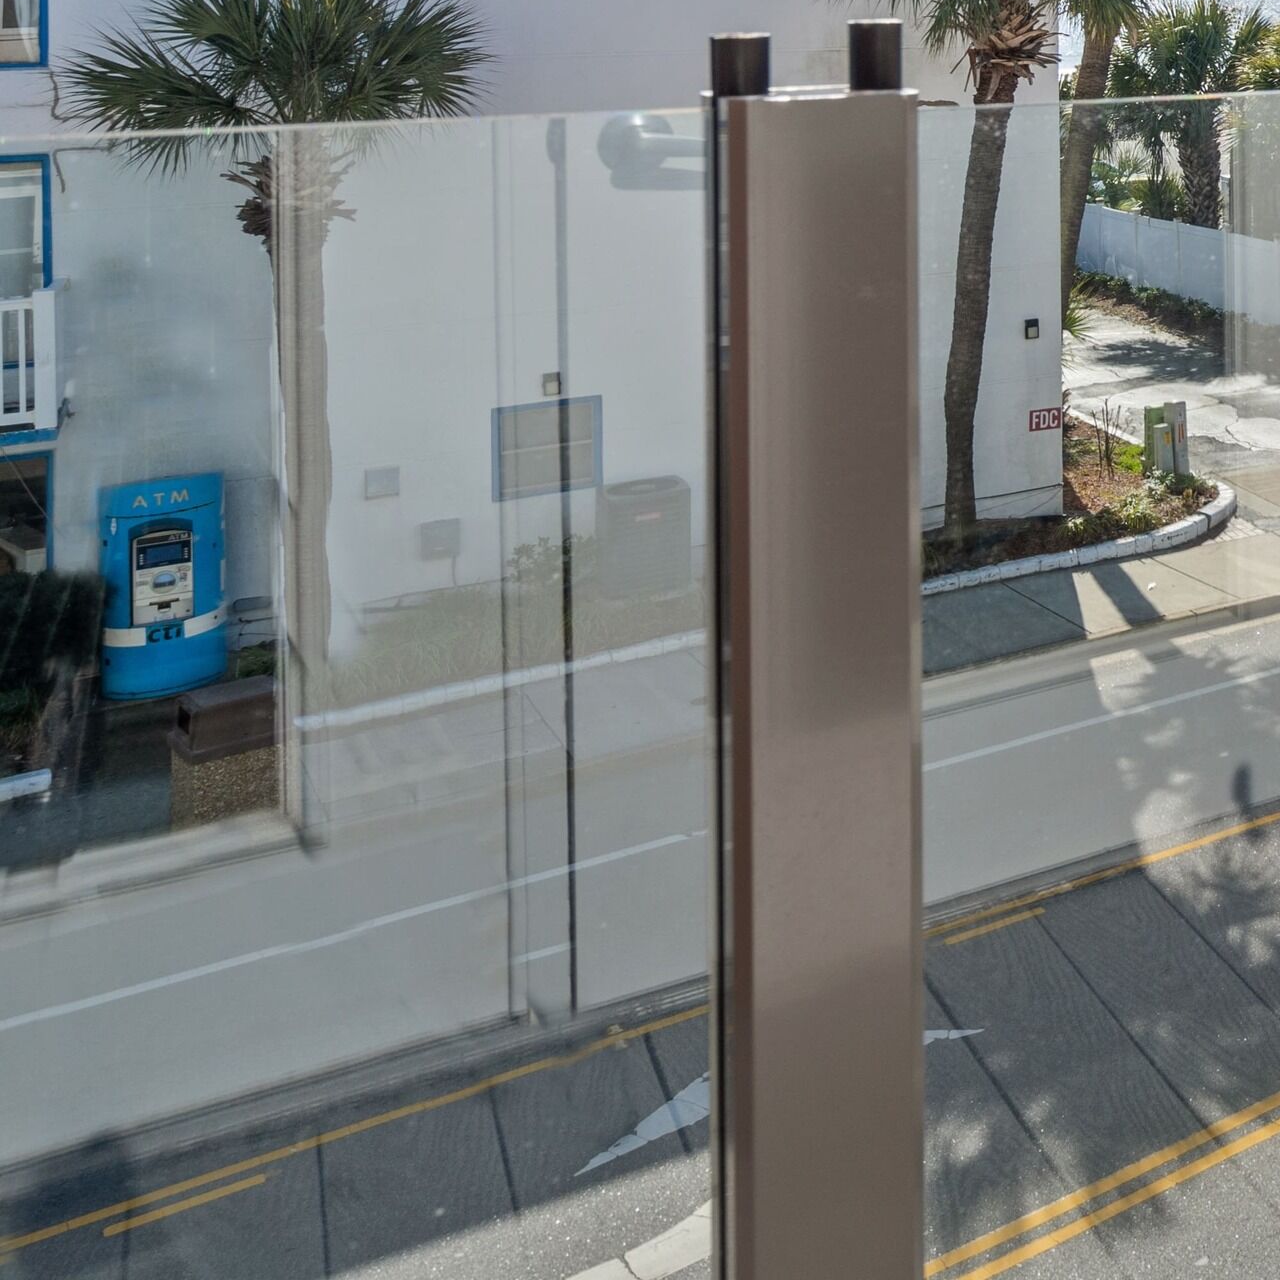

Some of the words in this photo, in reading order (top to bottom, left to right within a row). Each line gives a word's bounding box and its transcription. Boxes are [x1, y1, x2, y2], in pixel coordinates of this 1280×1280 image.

[1031, 409, 1059, 430] FDC
[132, 490, 189, 509] ATM
[167, 532, 190, 542] ATM
